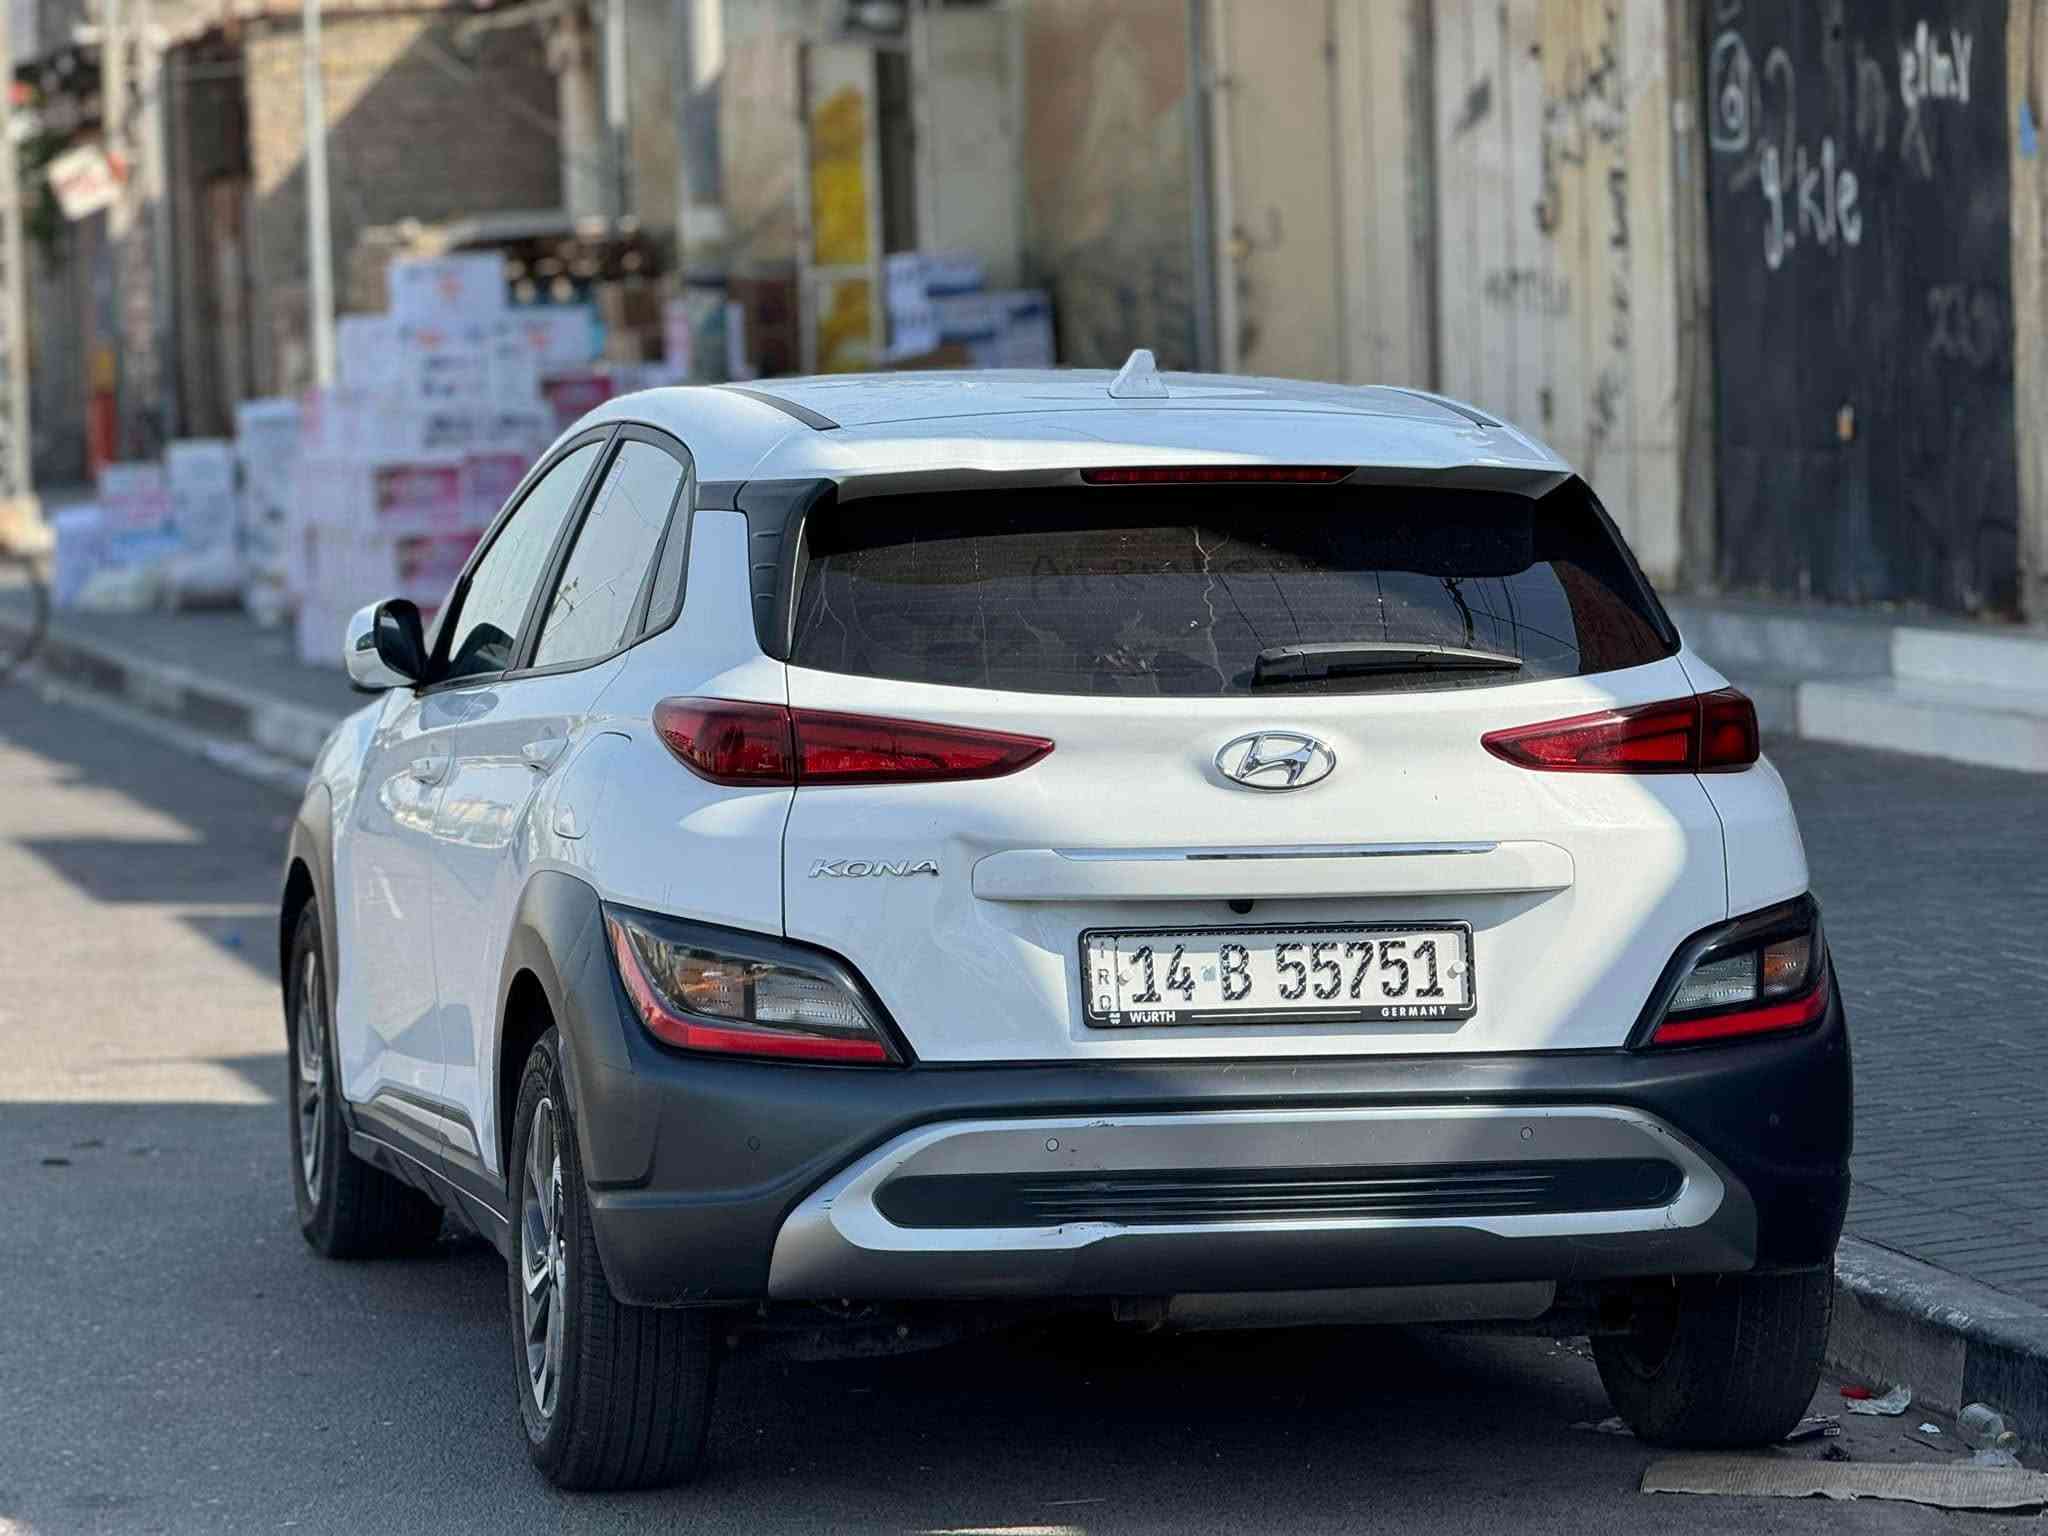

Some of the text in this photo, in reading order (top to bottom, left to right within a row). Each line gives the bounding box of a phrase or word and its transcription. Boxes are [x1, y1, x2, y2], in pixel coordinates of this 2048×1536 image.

[808, 858, 939, 878] KONA
[1129, 940, 1444, 1002] 14 B 55751
[1130, 1006, 1447, 1023] WÜRTH GERMANY
